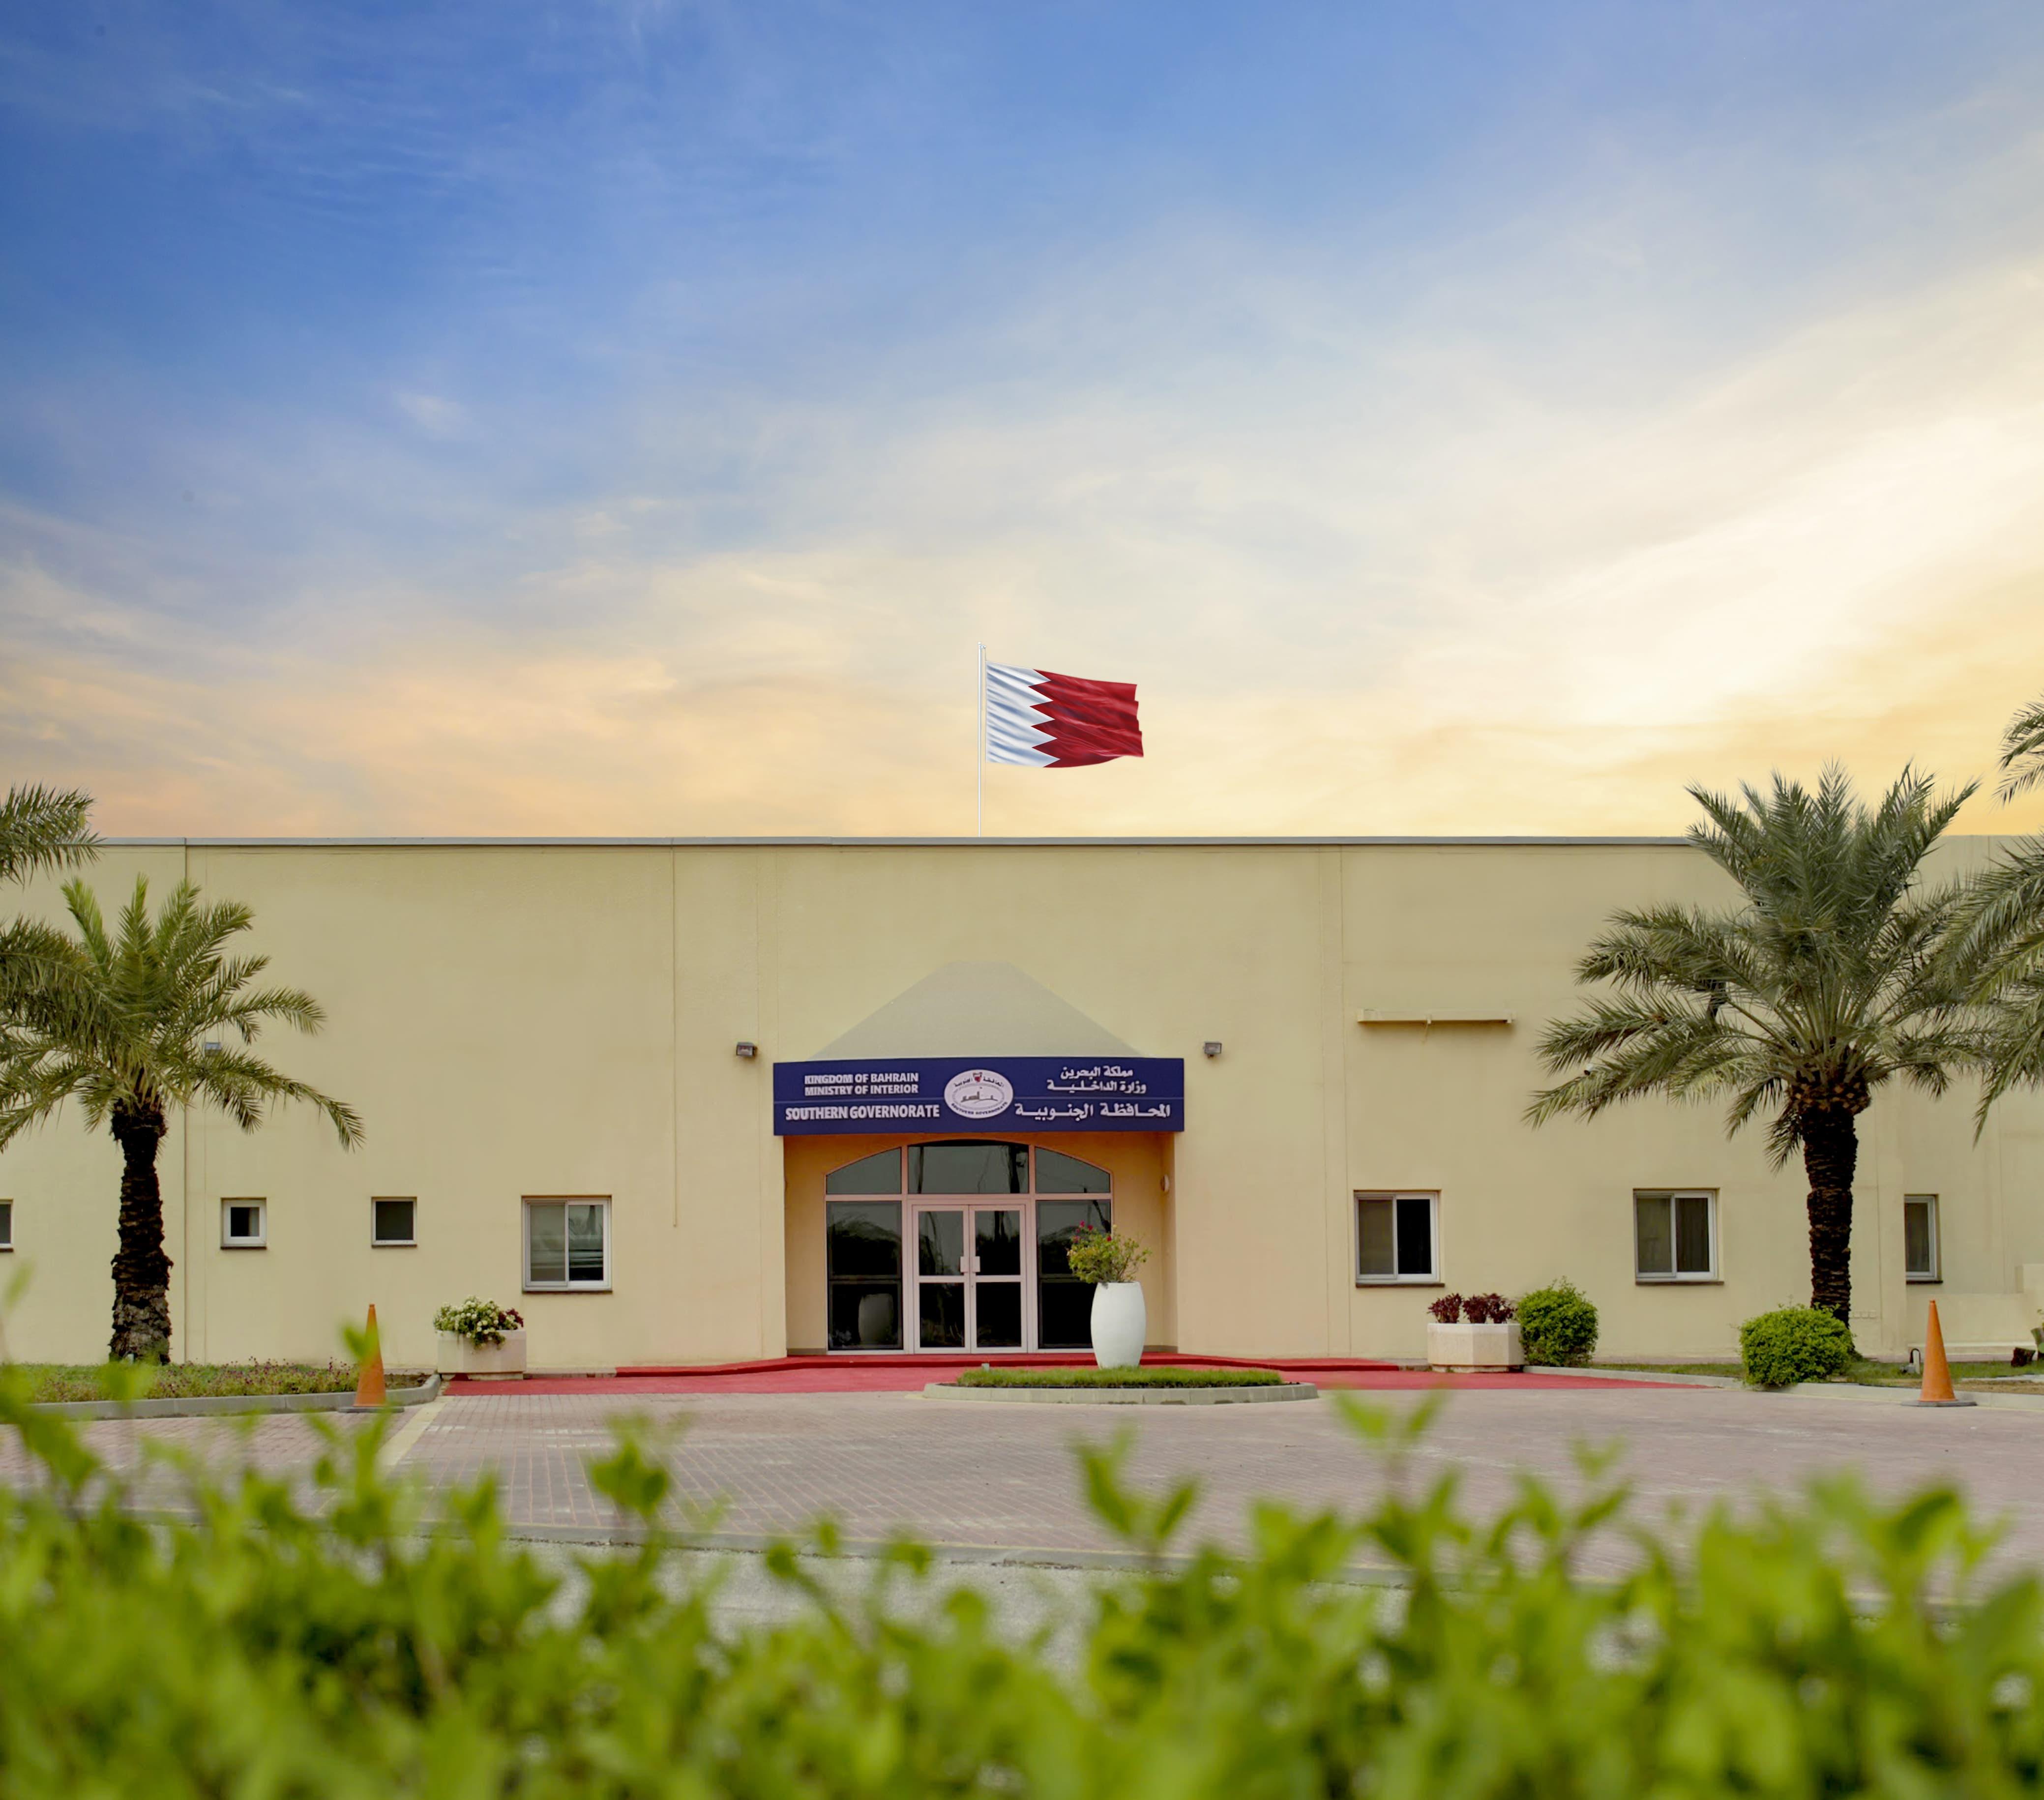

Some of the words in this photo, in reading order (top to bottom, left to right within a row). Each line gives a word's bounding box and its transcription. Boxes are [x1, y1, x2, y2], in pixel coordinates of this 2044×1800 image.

[1061, 1067, 1100, 1079] البحرين
[1104, 1066, 1133, 1077] مملكة
[805, 1074, 853, 1084] KINGDOM
[855, 1074, 868, 1083] OF
[871, 1073, 918, 1082] BAHRAIN
[805, 1086, 853, 1095] MINISTRY
[855, 1086, 868, 1094] OF
[871, 1085, 918, 1093] INTERIOR
[1120, 1081, 1146, 1093] وزارة
[786, 1107, 848, 1120] SOUTHERN
[850, 1105, 939, 1119] GOVERNORATE
[1015, 1103, 1093, 1121] الجنوبية
[1100, 1103, 1170, 1117] المحافظة
